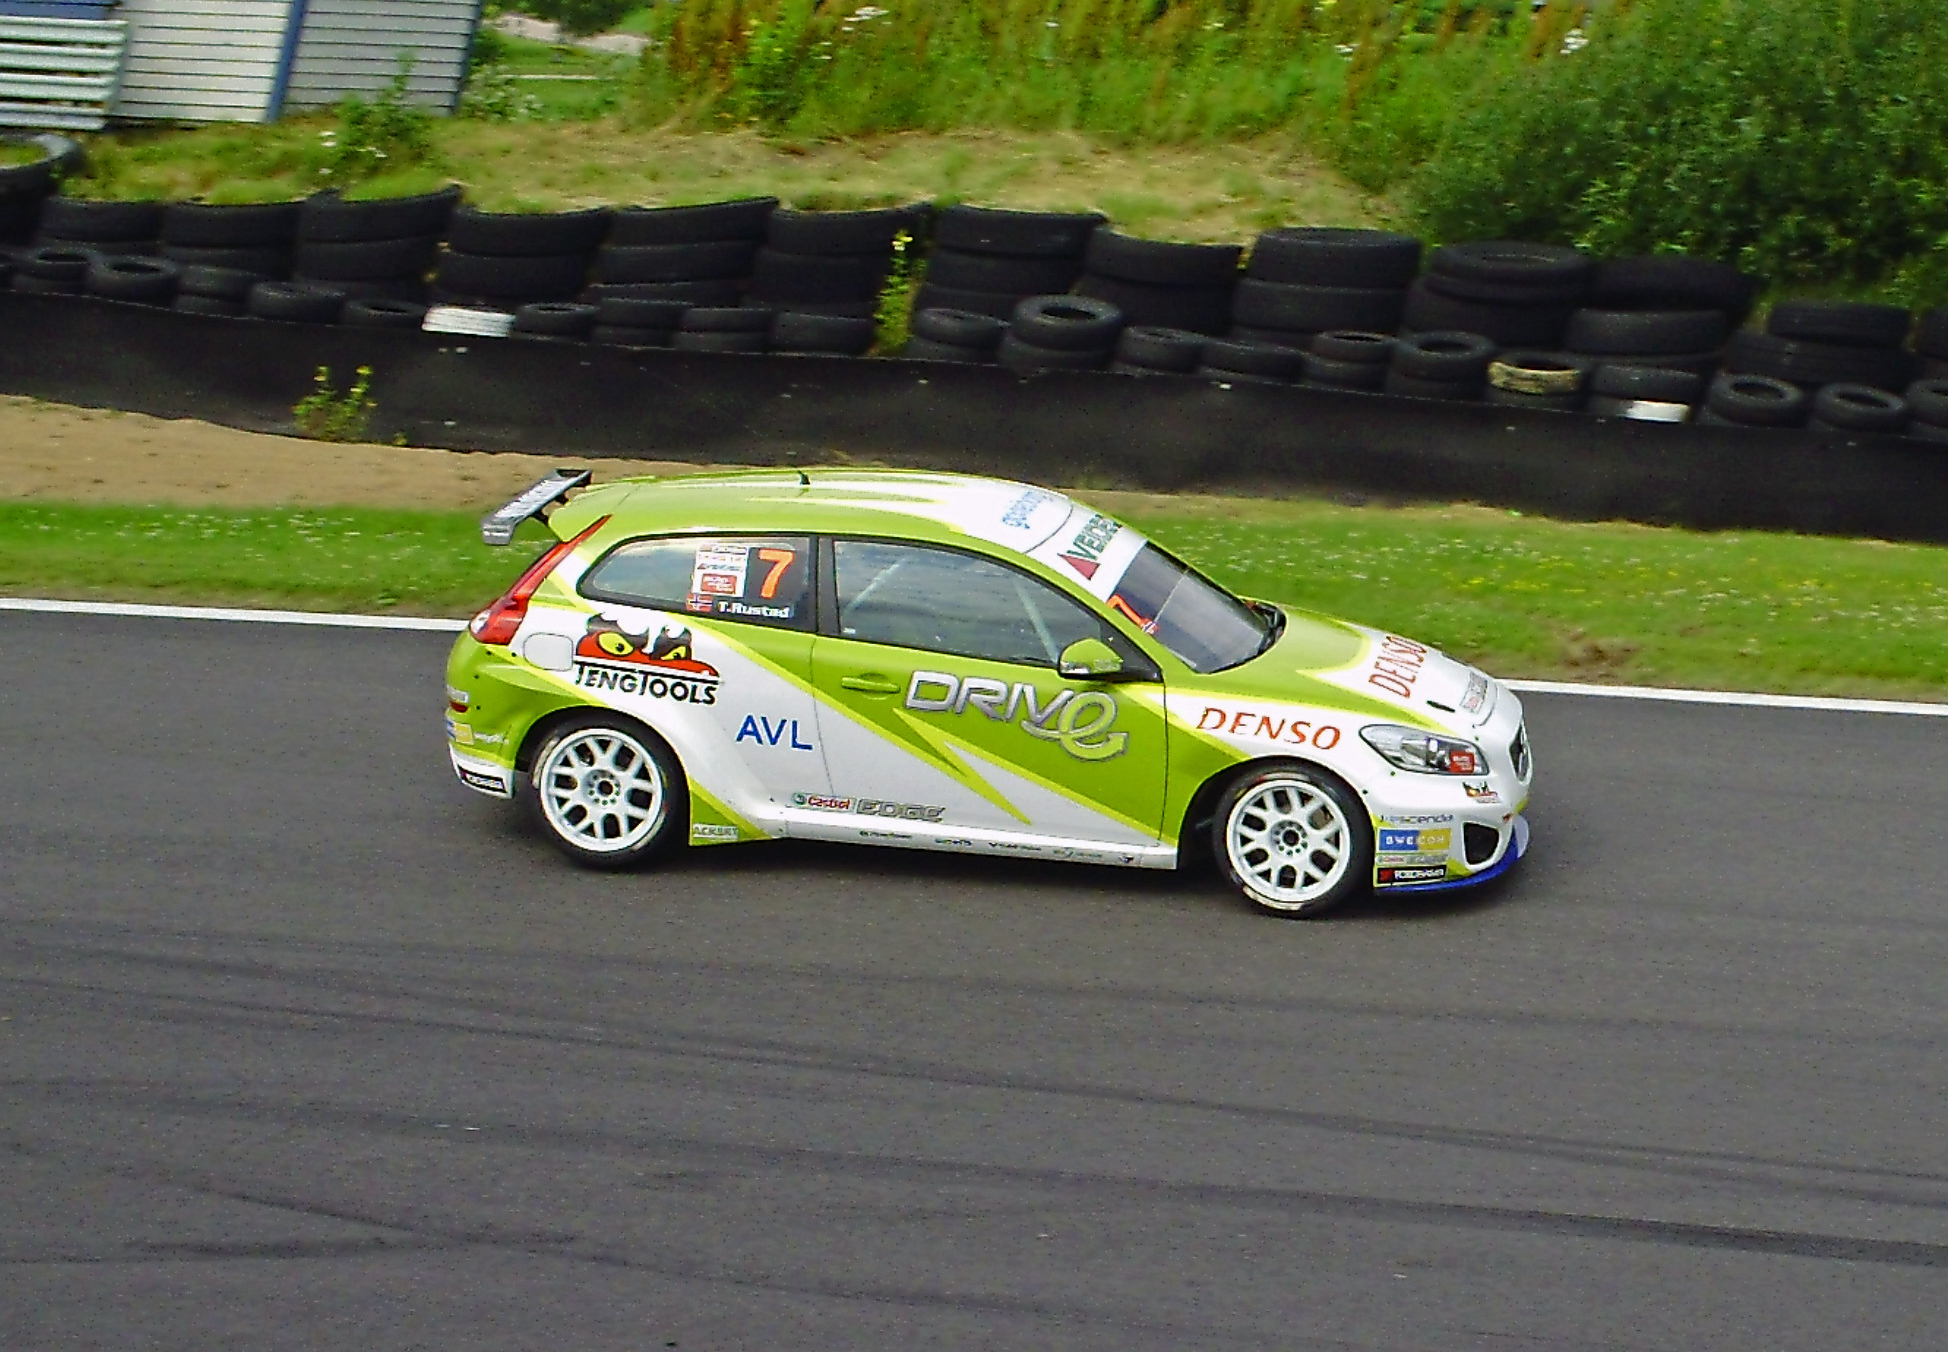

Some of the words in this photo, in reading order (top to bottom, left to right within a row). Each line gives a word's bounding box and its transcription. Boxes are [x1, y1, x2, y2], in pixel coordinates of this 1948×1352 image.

[758, 549, 794, 599] 7
[1106, 594, 1143, 627] 7
[1368, 635, 1427, 698] DENSO
[736, 714, 813, 750] AVL
[1196, 706, 1341, 749] DENSO
